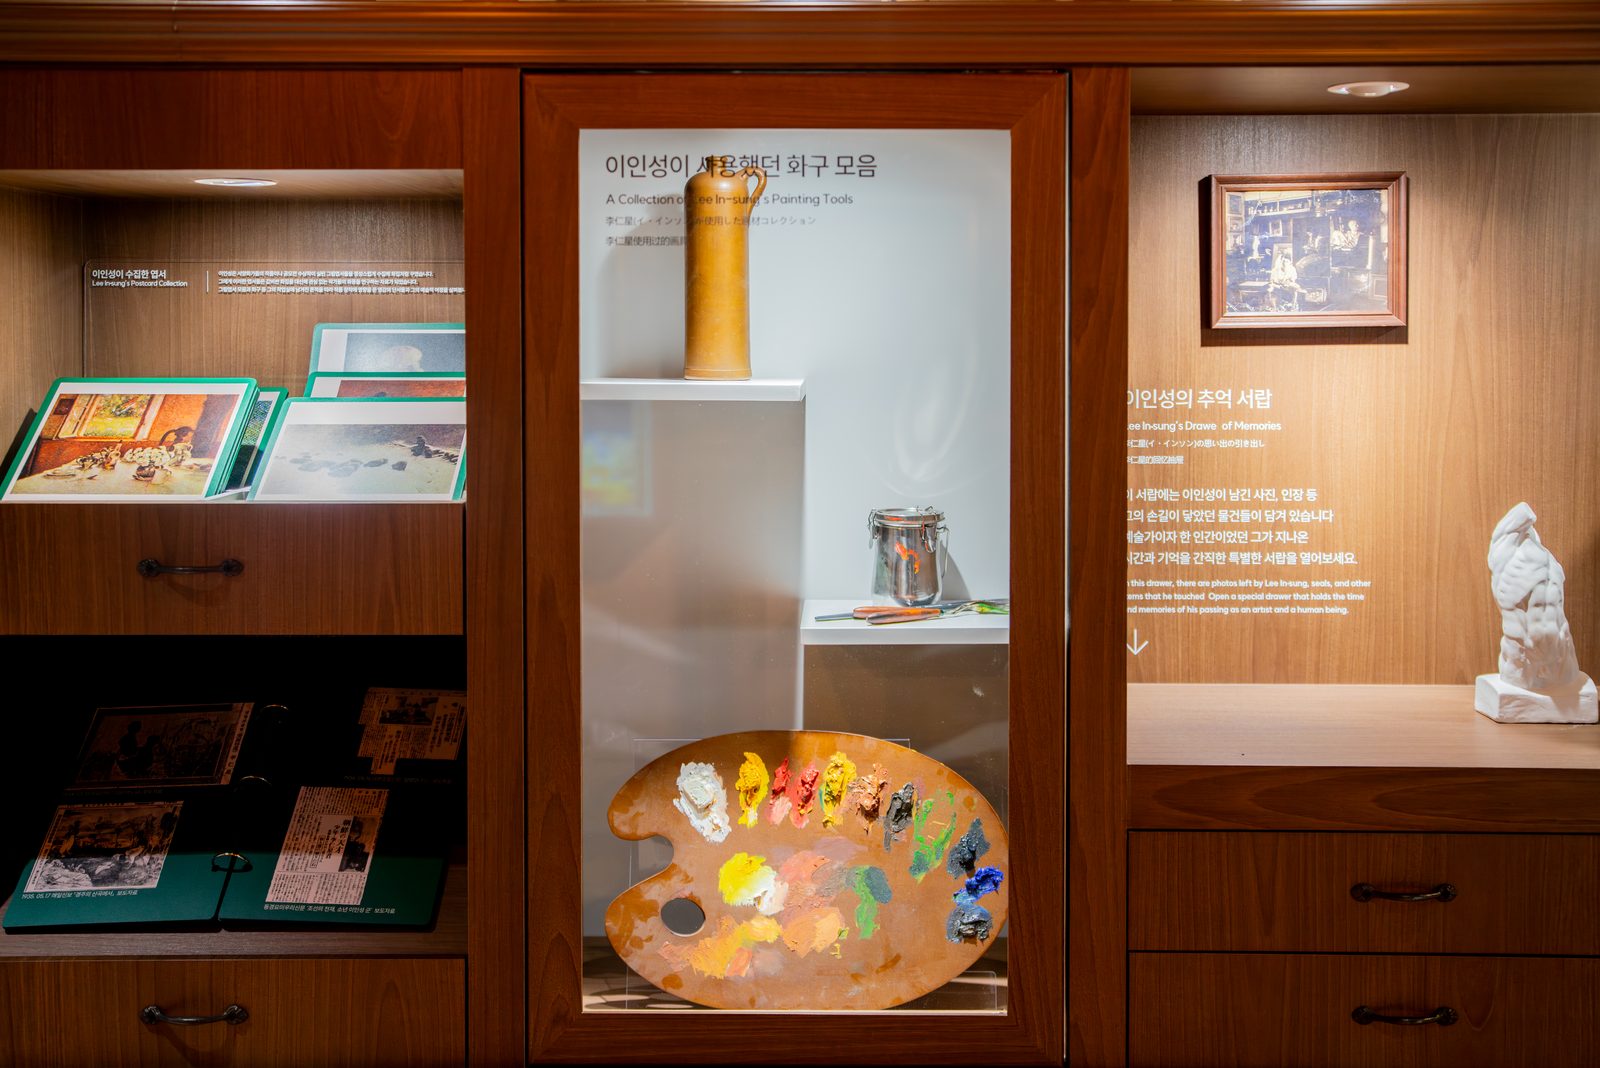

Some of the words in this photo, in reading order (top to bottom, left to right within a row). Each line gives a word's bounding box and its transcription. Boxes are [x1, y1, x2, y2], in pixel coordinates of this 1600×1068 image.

[606, 154, 689, 178] 이인성이
[697, 154, 780, 178] 사용했던
[787, 154, 829, 178] 화구
[835, 154, 878, 178] 모음
[606, 194, 615, 205] A
[618, 194, 675, 205] Collection
[677, 194, 688, 205] o
[693, 194, 713, 205] ee
[772, 194, 820, 206] Painting
[823, 194, 853, 205] Tools
[92, 269, 124, 279] 이인성이
[125, 269, 149, 279] 수집한
[150, 269, 167, 279] 엽서
[1127, 389, 1193, 409] 이인성의
[1197, 389, 1232, 409] 추억
[1237, 389, 1272, 409] 서랍
[1127, 422, 1140, 431] ee
[1186, 421, 1217, 431] Drawe
[1222, 421, 1233, 431] of
[1234, 421, 1281, 431] Memories
[1136, 488, 1180, 501] 서랍에는
[1182, 488, 1226, 501] 이인성이
[1229, 488, 1251, 501] 남긴
[1253, 488, 1278, 502] 사진,
[1281, 488, 1304, 501] 인장
[1306, 488, 1318, 501] 등
[1147, 509, 1180, 523] 손길이
[1182, 509, 1215, 523] 닿았던
[1218, 509, 1262, 523] 물건들이
[1264, 509, 1287, 523] 담겨
[1289, 509, 1334, 523] 있습니다
[1180, 530, 1191, 544] 한
[1193, 530, 1248, 544] 인간이었던
[1250, 530, 1273, 544] 그가
[1275, 530, 1309, 544] 지나온
[1157, 551, 1191, 565] 기억을
[1193, 551, 1226, 565] 간직한
[1229, 551, 1262, 565] 특별한
[1264, 551, 1297, 565] 서랍을
[1300, 551, 1358, 565] 열어보세요.
[1211, 580, 1238, 588] photos
[1254, 580, 1263, 588] by
[1208, 593, 1230, 602] Open
[1238, 593, 1264, 602] special
[1127, 606, 1137, 614] nd
[1138, 606, 1175, 614] memories
[1177, 606, 1186, 614] of
[1187, 606, 1198, 614] his
[1199, 606, 1229, 615] passing
[1252, 606, 1273, 614] artist
[1274, 606, 1289, 614] and
[1297, 606, 1324, 614] human
[1325, 606, 1349, 615] being.
